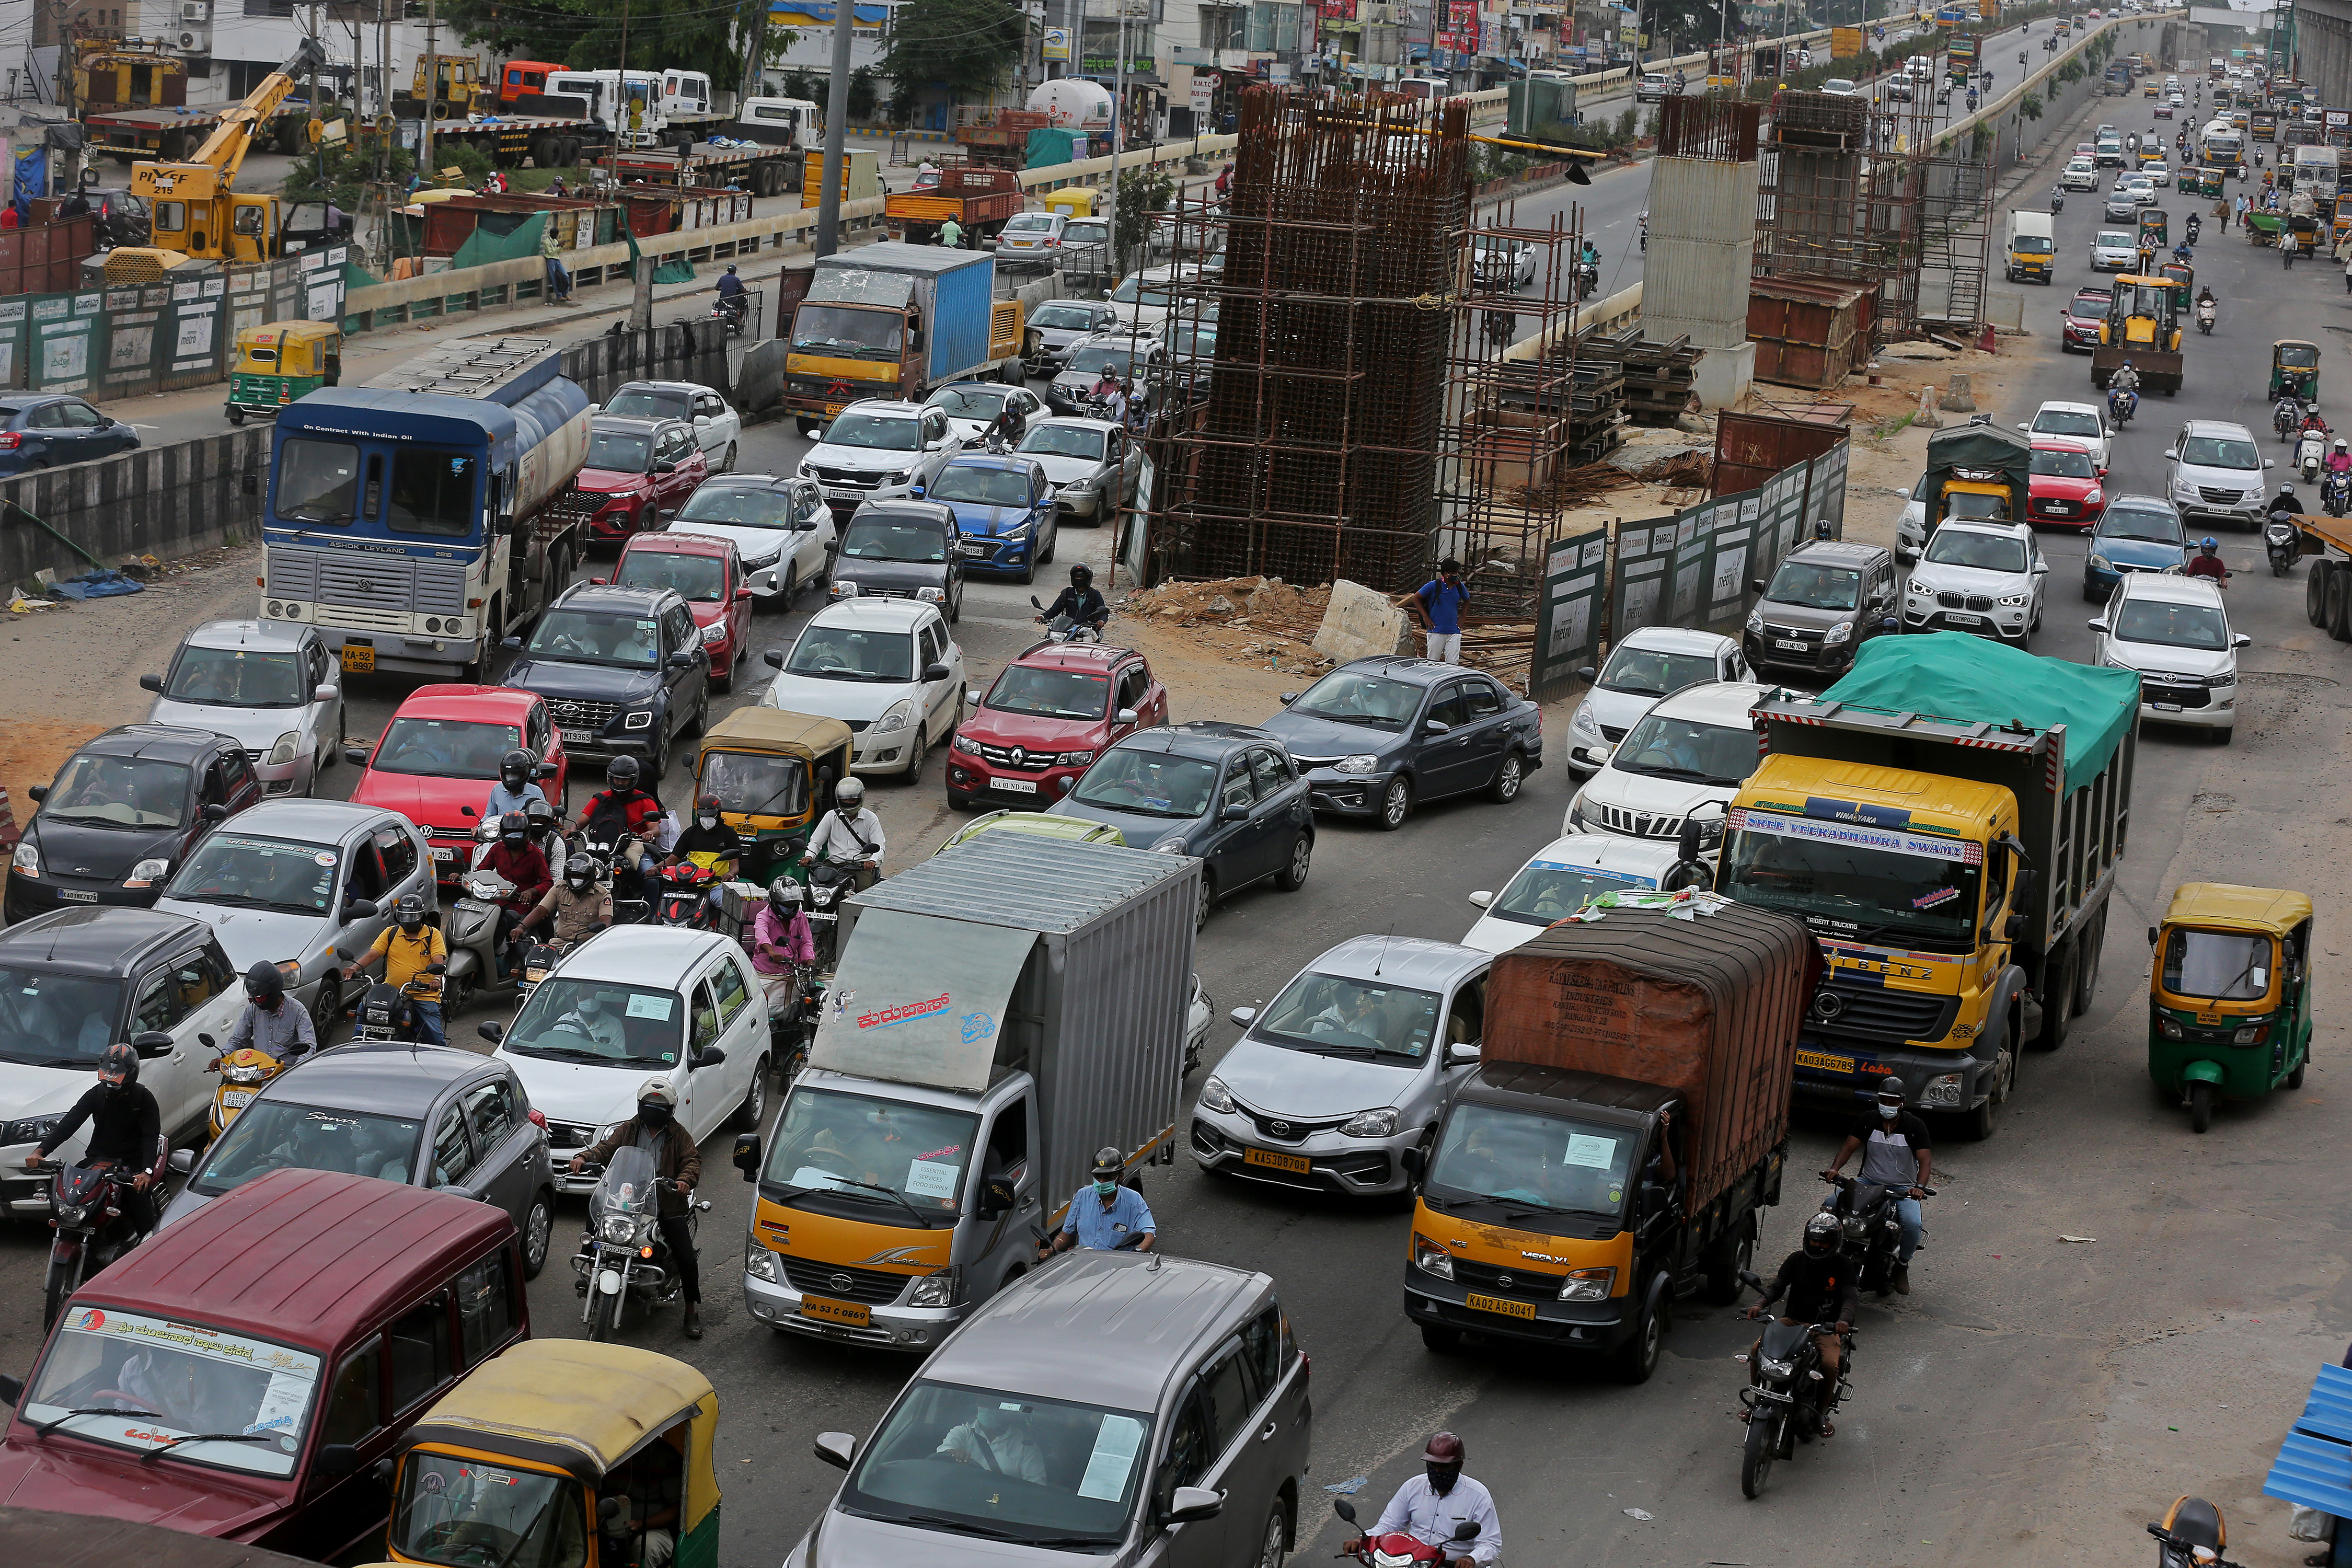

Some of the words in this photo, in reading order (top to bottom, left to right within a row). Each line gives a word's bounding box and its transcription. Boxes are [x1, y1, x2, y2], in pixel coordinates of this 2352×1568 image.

[154, 186, 174, 194] 215
[330, 251, 344, 261] BMRCL
[206, 281, 222, 291] BMRCL
[311, 304, 324, 314] metro
[180, 335, 196, 345] metro
[315, 425, 349, 434] Contract
[1742, 504, 1756, 516] BMRCL
[1699, 515, 1711, 528] BMRCL
[1656, 533, 1673, 546] BMRCL
[329, 541, 362, 552] ASHOK
[364, 545, 406, 555] LEYLAND
[1585, 545, 1601, 559] BMRCL
[1715, 573, 1730, 588] metro
[1626, 607, 1642, 620] metro
[1553, 626, 1571, 642] metro
[345, 651, 370, 661] KA-52
[343, 661, 373, 671] A-8997
[1753, 800, 1808, 813] ATTILAKAMMA
[1746, 812, 1786, 832] SREE
[1789, 820, 1901, 850] VEERABHADRA
[1906, 837, 1964, 858] SWAMY
[1898, 821, 1961, 836] JALADIGEREAMMA
[241, 840, 295, 852] Kempamma
[296, 847, 319, 856] Devi
[438, 851, 451, 860] 321
[1806, 917, 1830, 926] TRIDENT
[1831, 919, 1858, 930] TRUCKING
[1598, 1017, 1607, 1025] 22
[1797, 1052, 1853, 1071] KA03AG6789
[227, 1092, 247, 1101] KA03K
[227, 1099, 246, 1108] E8275
[305, 1112, 360, 1125] Sanvi
[1253, 1151, 1306, 1172] KA53D8708
[920, 1166, 947, 1176] ESSENTIAL
[918, 1173, 941, 1183] SERVICES
[913, 1181, 929, 1189] FOOD
[930, 1183, 949, 1193] SUPPLY
[1450, 1238, 1467, 1249] ACE
[599, 1243, 639, 1258] KA-03JV-7783
[1521, 1250, 1552, 1262] MEGA
[1552, 1255, 1571, 1266] XL
[805, 1302, 816, 1311] KA
[820, 1305, 831, 1313] 53
[843, 1309, 868, 1320] 0869
[118, 1321, 134, 1334] ಶ್ರೀ
[134, 1323, 193, 1346] ಮಂಜುನಾಥ
[193, 1335, 223, 1354] ಸ್ವಾಮಿ
[223, 1343, 253, 1362] ಪ್ರಸನ್ನ
